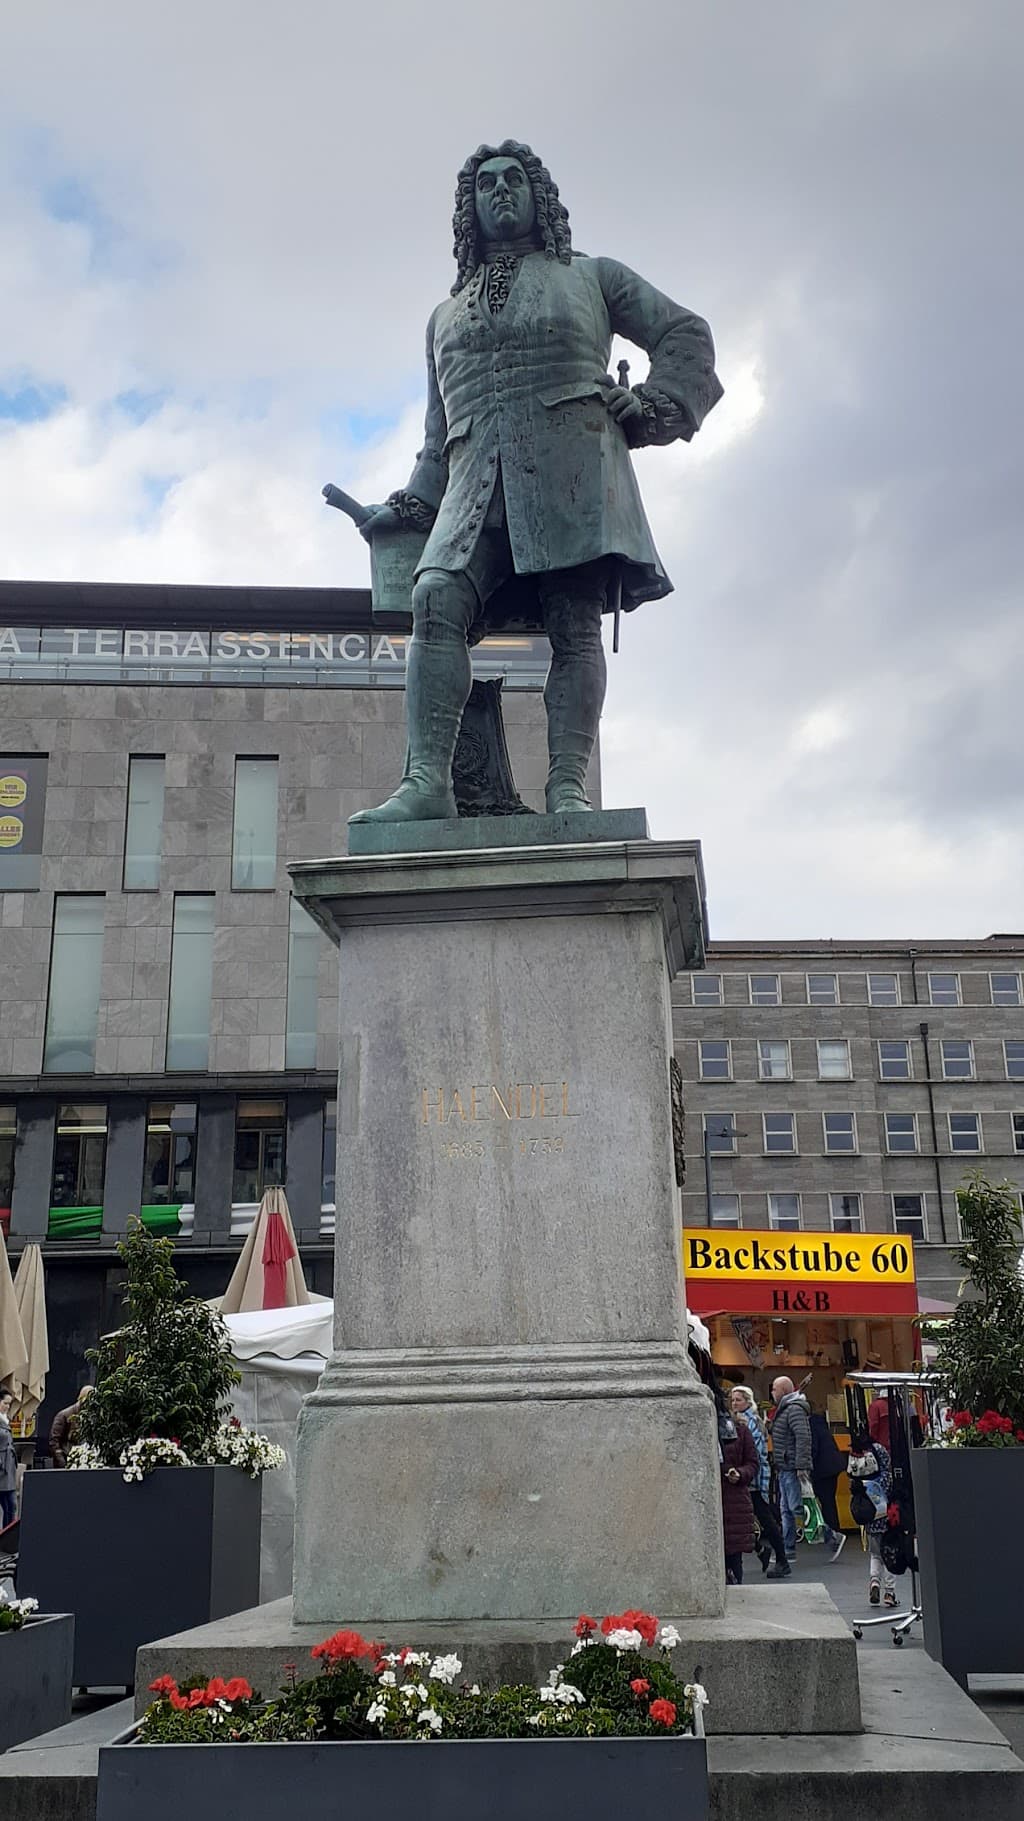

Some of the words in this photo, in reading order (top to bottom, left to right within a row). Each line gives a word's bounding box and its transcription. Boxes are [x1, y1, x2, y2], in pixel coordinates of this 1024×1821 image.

[421, 1081, 582, 1125] HAENDEL
[441, 1140, 485, 1159] 1685
[687, 1238, 861, 1272] Backstube
[871, 1243, 908, 1274] 60
[771, 1289, 830, 1312] H&B
